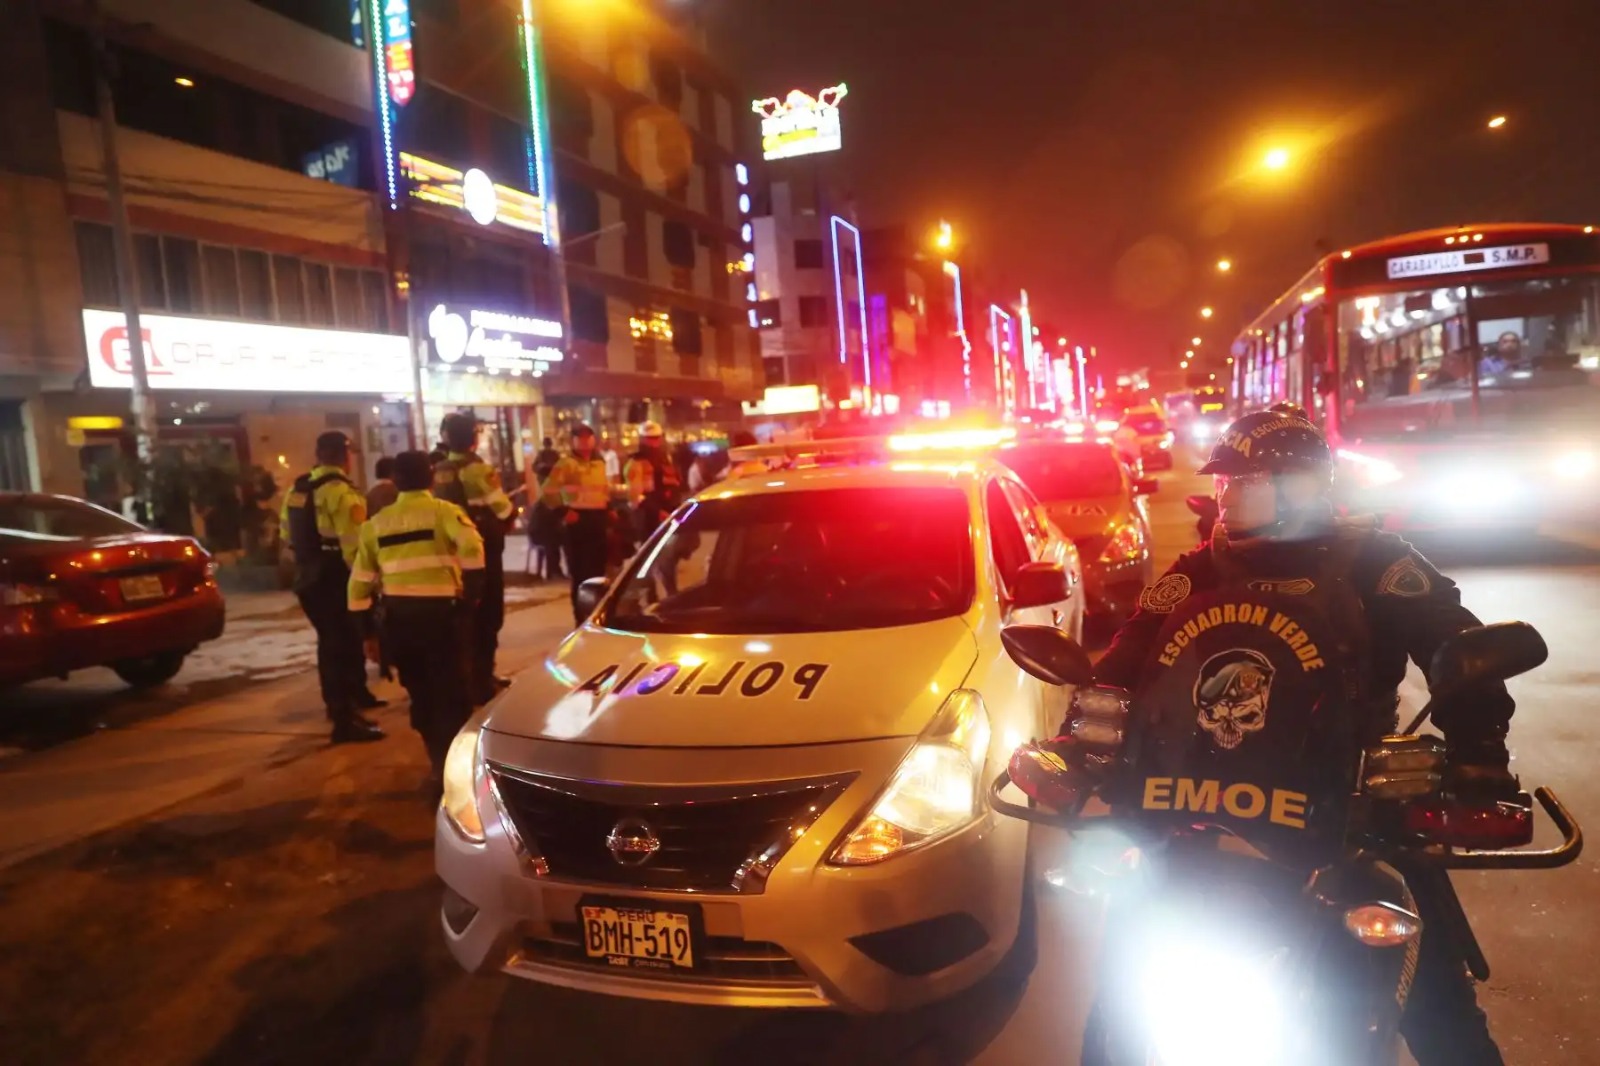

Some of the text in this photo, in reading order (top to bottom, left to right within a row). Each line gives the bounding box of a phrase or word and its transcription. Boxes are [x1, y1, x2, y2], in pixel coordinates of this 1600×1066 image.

[1390, 247, 1537, 275] CARABAYLLO S.M.P.
[1158, 603, 1325, 672] ESCUADRON VERDE
[1143, 777, 1308, 828] EMOE
[588, 920, 688, 960] BMH-519
